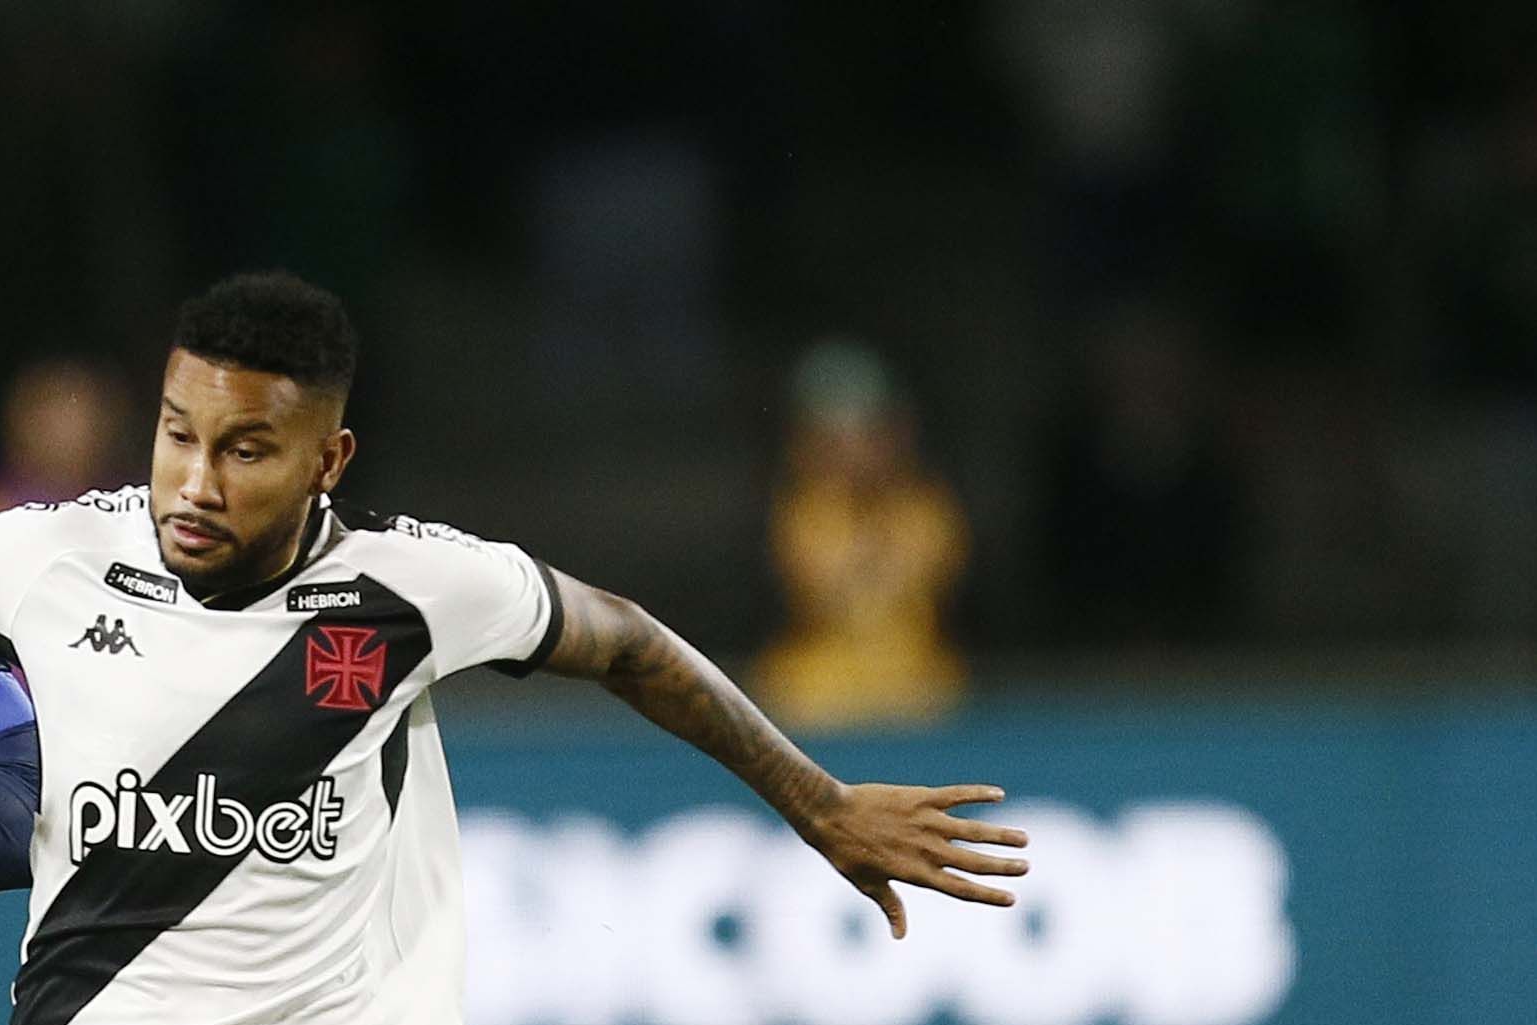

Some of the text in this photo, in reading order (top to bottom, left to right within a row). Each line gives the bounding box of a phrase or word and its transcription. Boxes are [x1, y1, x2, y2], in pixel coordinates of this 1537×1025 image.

[117, 572, 175, 603] HEBRON
[298, 591, 361, 609] HEBRON
[69, 768, 344, 866] pixbet
